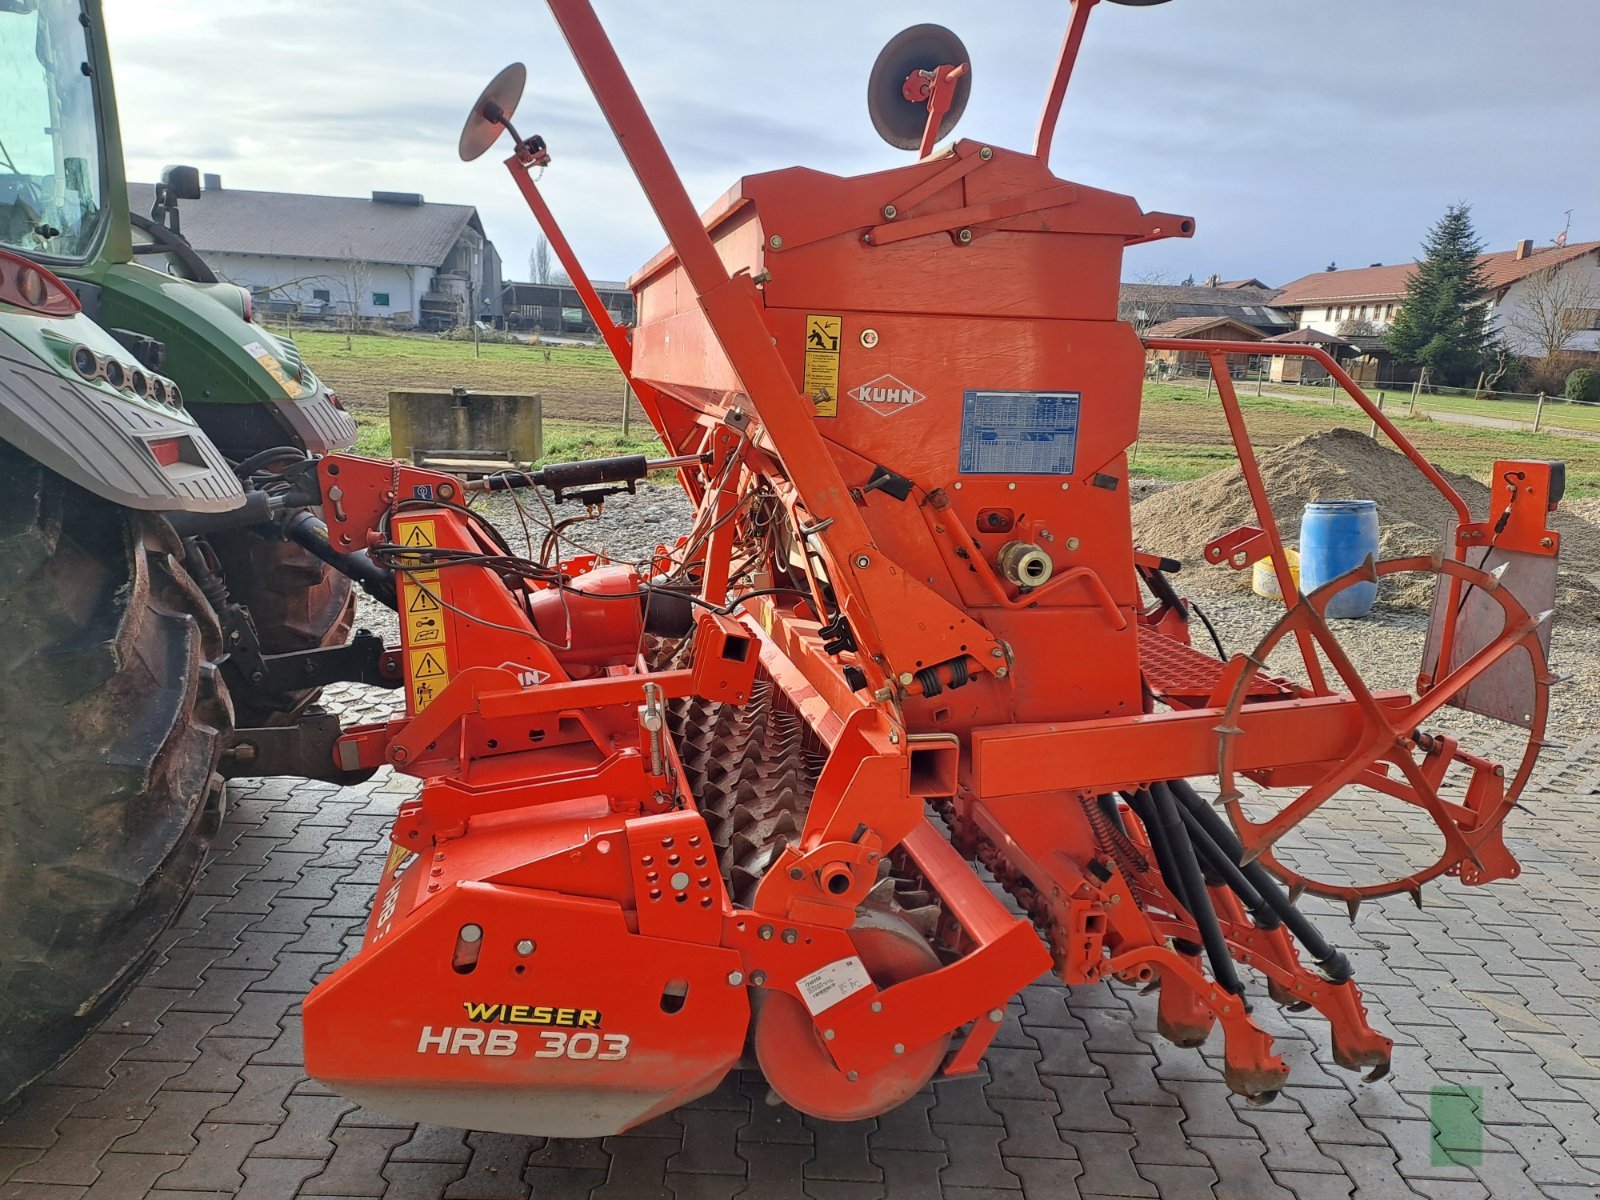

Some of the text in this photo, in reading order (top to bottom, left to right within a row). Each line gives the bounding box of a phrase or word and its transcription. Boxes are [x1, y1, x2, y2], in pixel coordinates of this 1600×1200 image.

[858, 386, 915, 404] KUHN
[463, 1001, 602, 1029] WIESER
[417, 1026, 630, 1061] HRB 303
